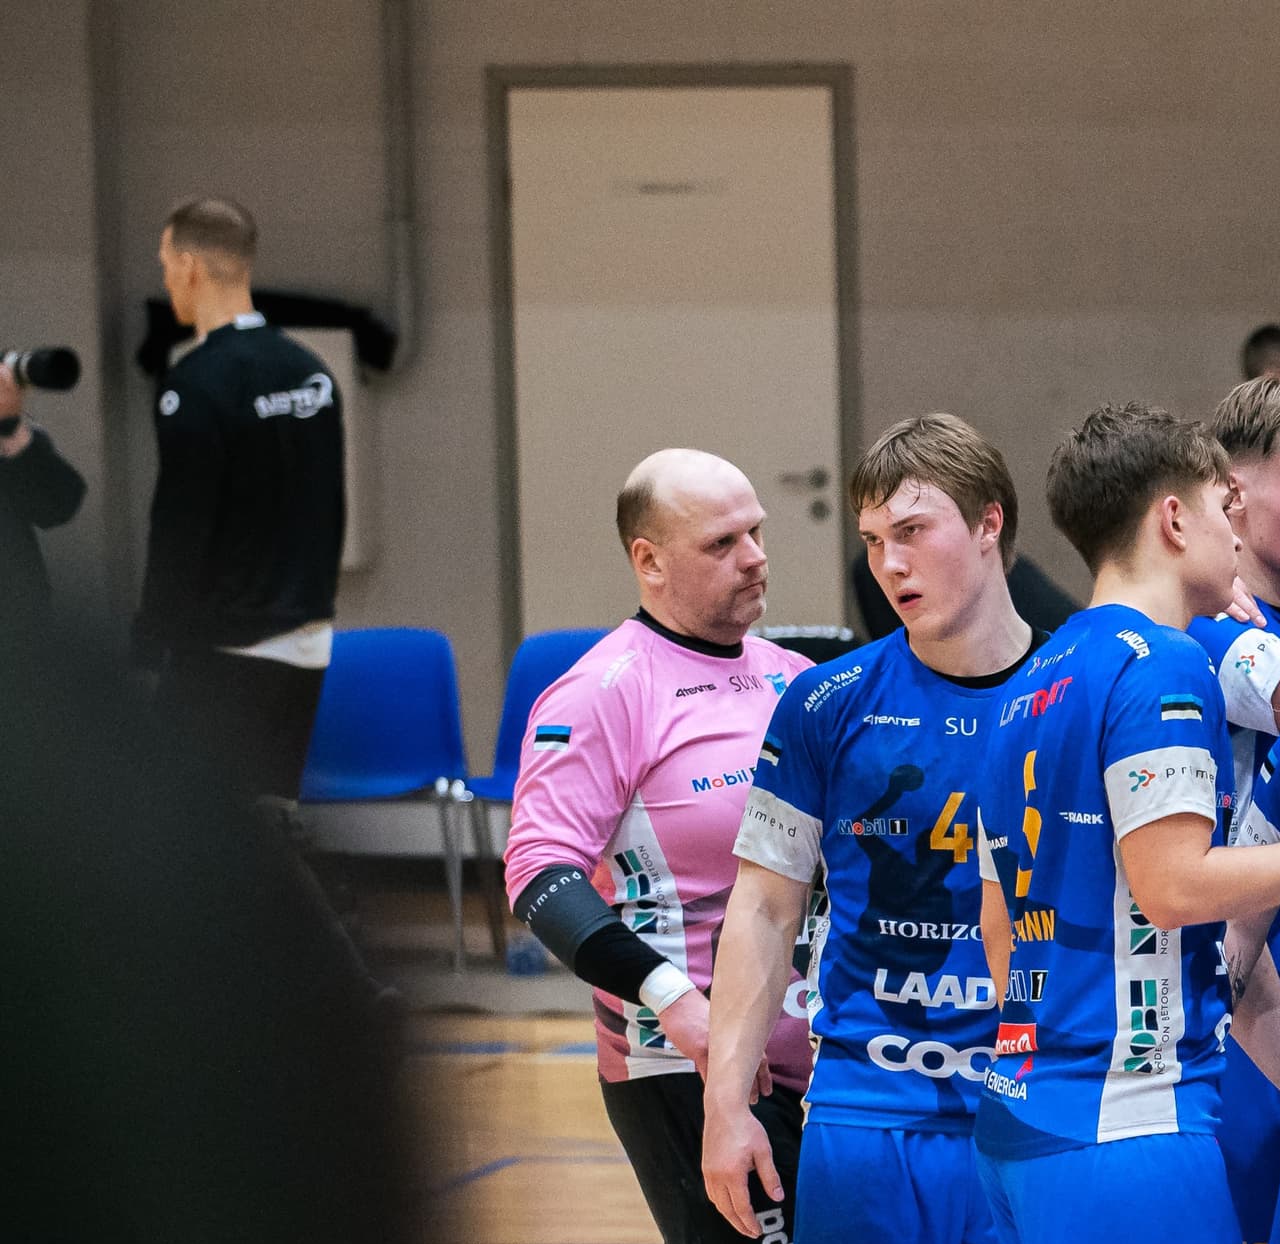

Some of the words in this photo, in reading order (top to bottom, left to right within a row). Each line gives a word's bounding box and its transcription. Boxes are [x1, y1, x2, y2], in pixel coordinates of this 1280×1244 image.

[803, 678, 834, 713] ANIJA
[831, 665, 864, 684] VALD
[1000, 676, 1074, 729] LIFTRNT
[944, 717, 978, 737] SU
[691, 769, 750, 793] Mobil
[747, 807, 798, 838] imend
[837, 819, 887, 836] Mobil
[929, 791, 974, 864] 4
[1013, 909, 1055, 951] ANN
[874, 968, 997, 1010] LAAD
[1160, 977, 1171, 1022] BETOON
[866, 1034, 999, 1082] COO
[986, 1066, 1028, 1101] ENERGIA
